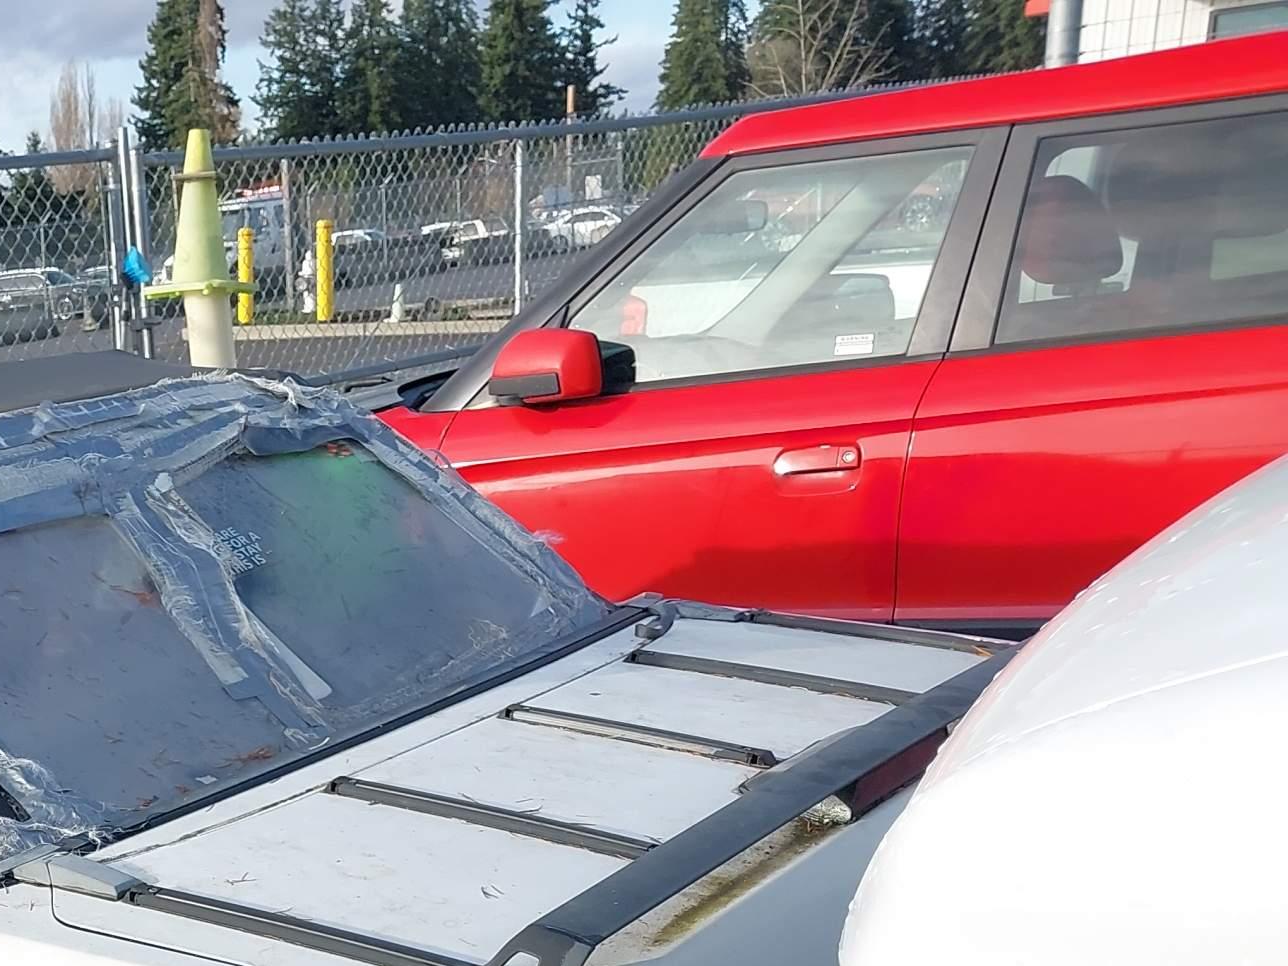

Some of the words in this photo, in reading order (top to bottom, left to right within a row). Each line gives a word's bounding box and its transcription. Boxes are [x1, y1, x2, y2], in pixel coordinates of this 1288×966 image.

[215, 527, 240, 542] ARE
[248, 531, 261, 542] A
[233, 542, 263, 560] STAY
[252, 554, 267, 566] IS
